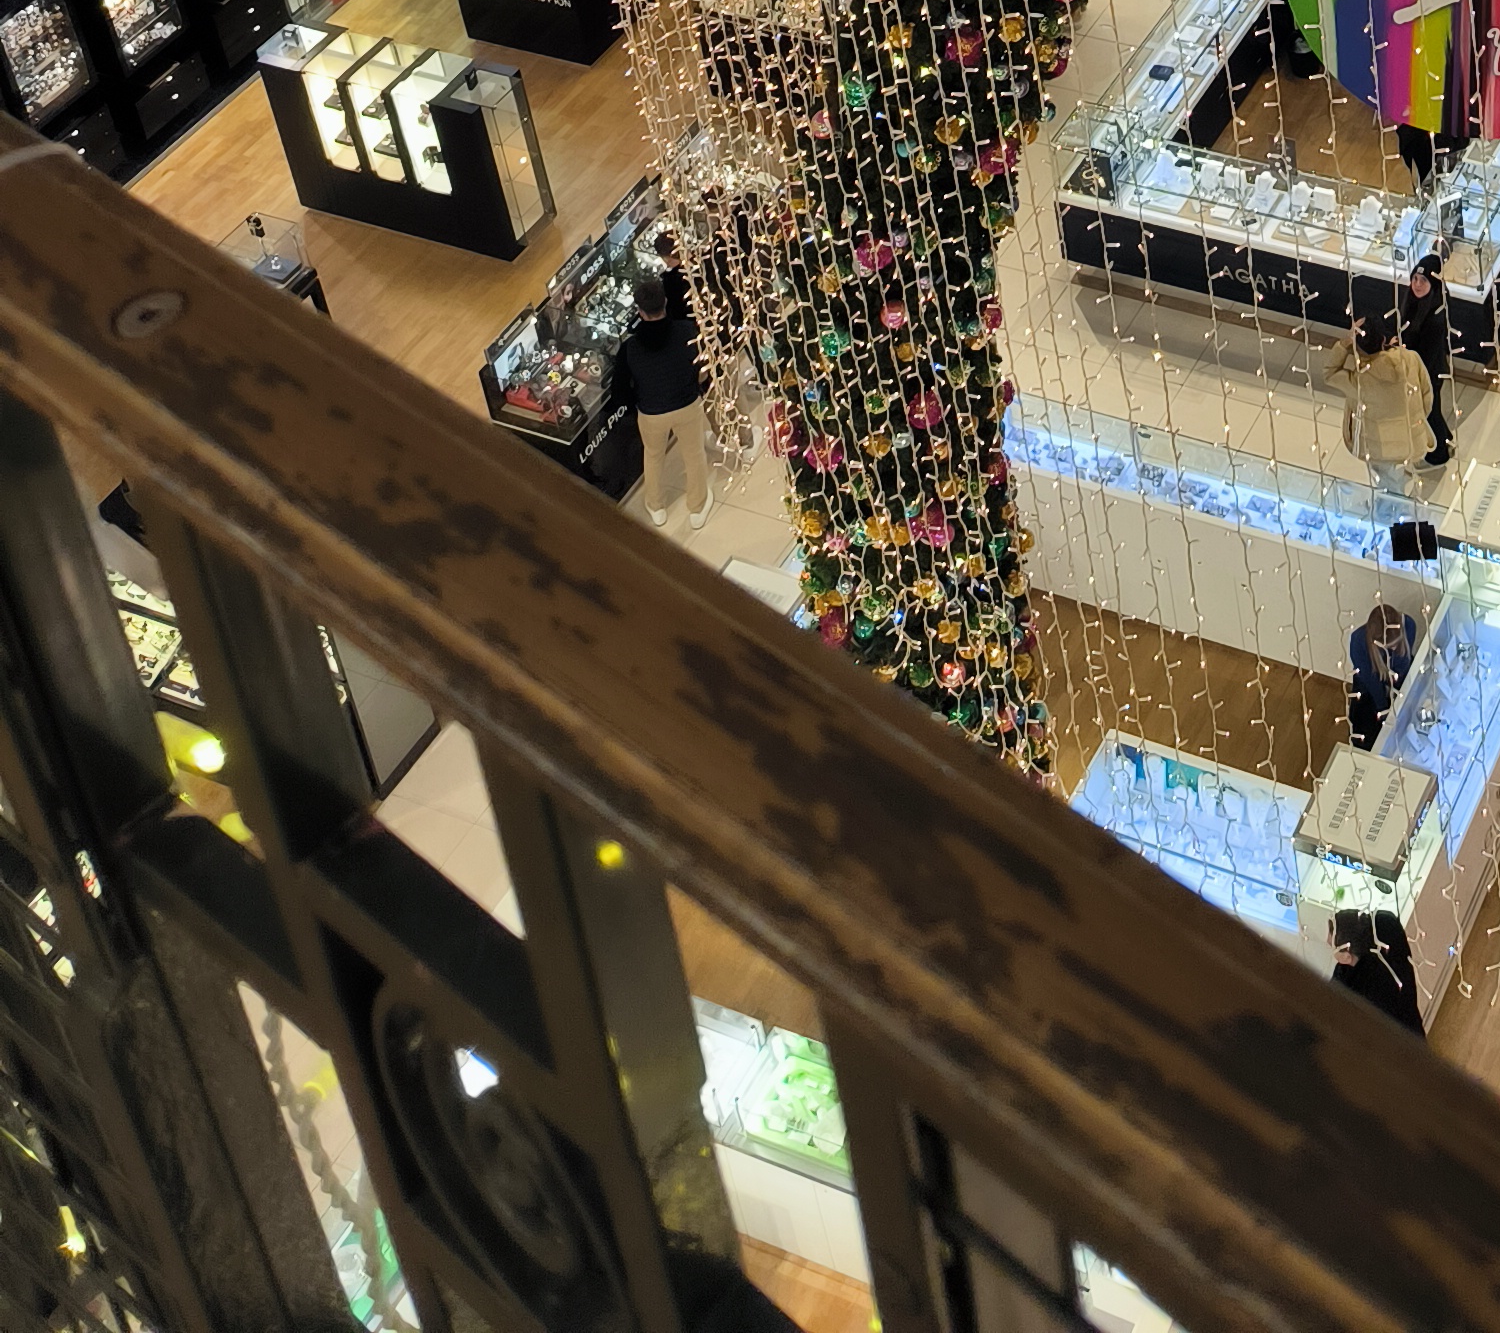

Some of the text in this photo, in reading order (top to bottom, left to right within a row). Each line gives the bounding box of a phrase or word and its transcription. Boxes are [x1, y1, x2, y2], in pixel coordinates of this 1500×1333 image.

[580, 254, 605, 285] BOSS
[1222, 264, 1311, 297] AGATHA
[579, 426, 608, 464] LOUIS
